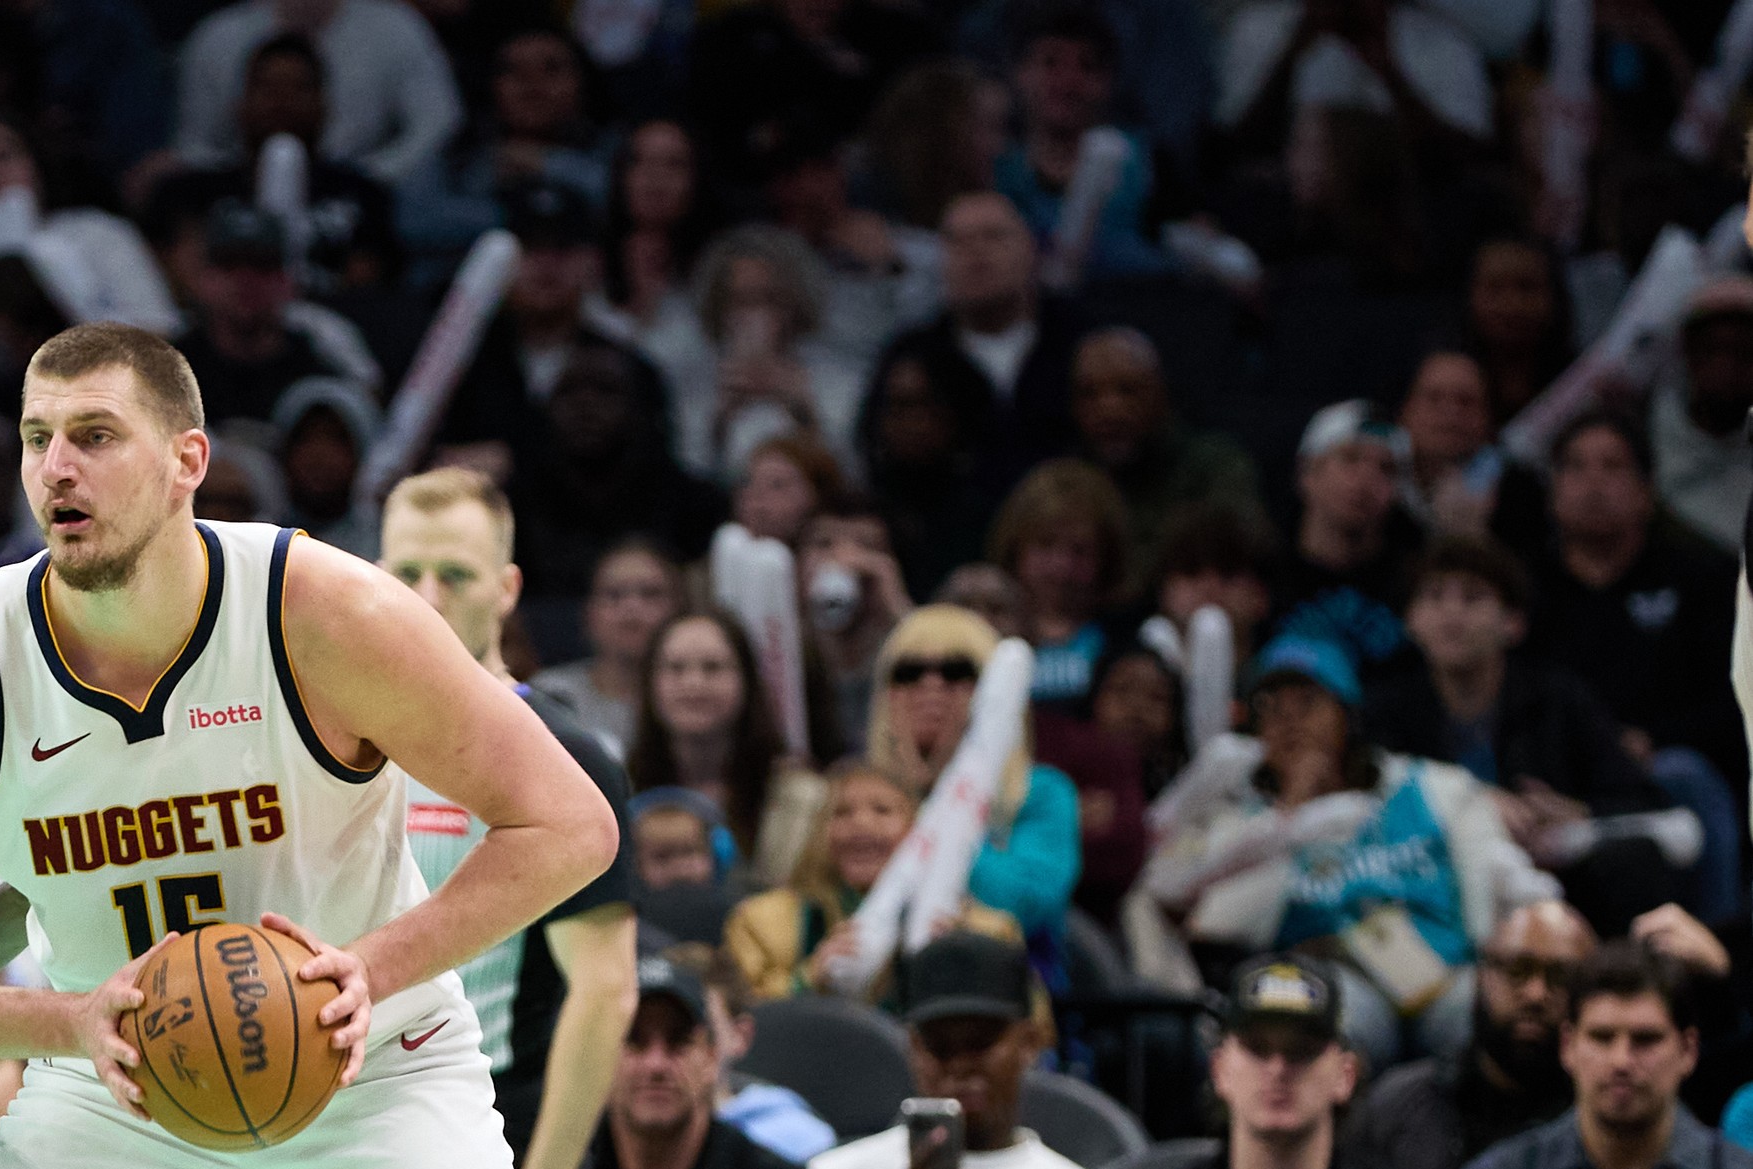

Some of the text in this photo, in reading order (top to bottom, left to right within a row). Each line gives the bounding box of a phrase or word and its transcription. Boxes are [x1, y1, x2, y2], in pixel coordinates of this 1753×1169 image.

[189, 704, 262, 729] ibotta
[22, 782, 286, 876] NUGGETS
[214, 934, 270, 1075] Wilson
